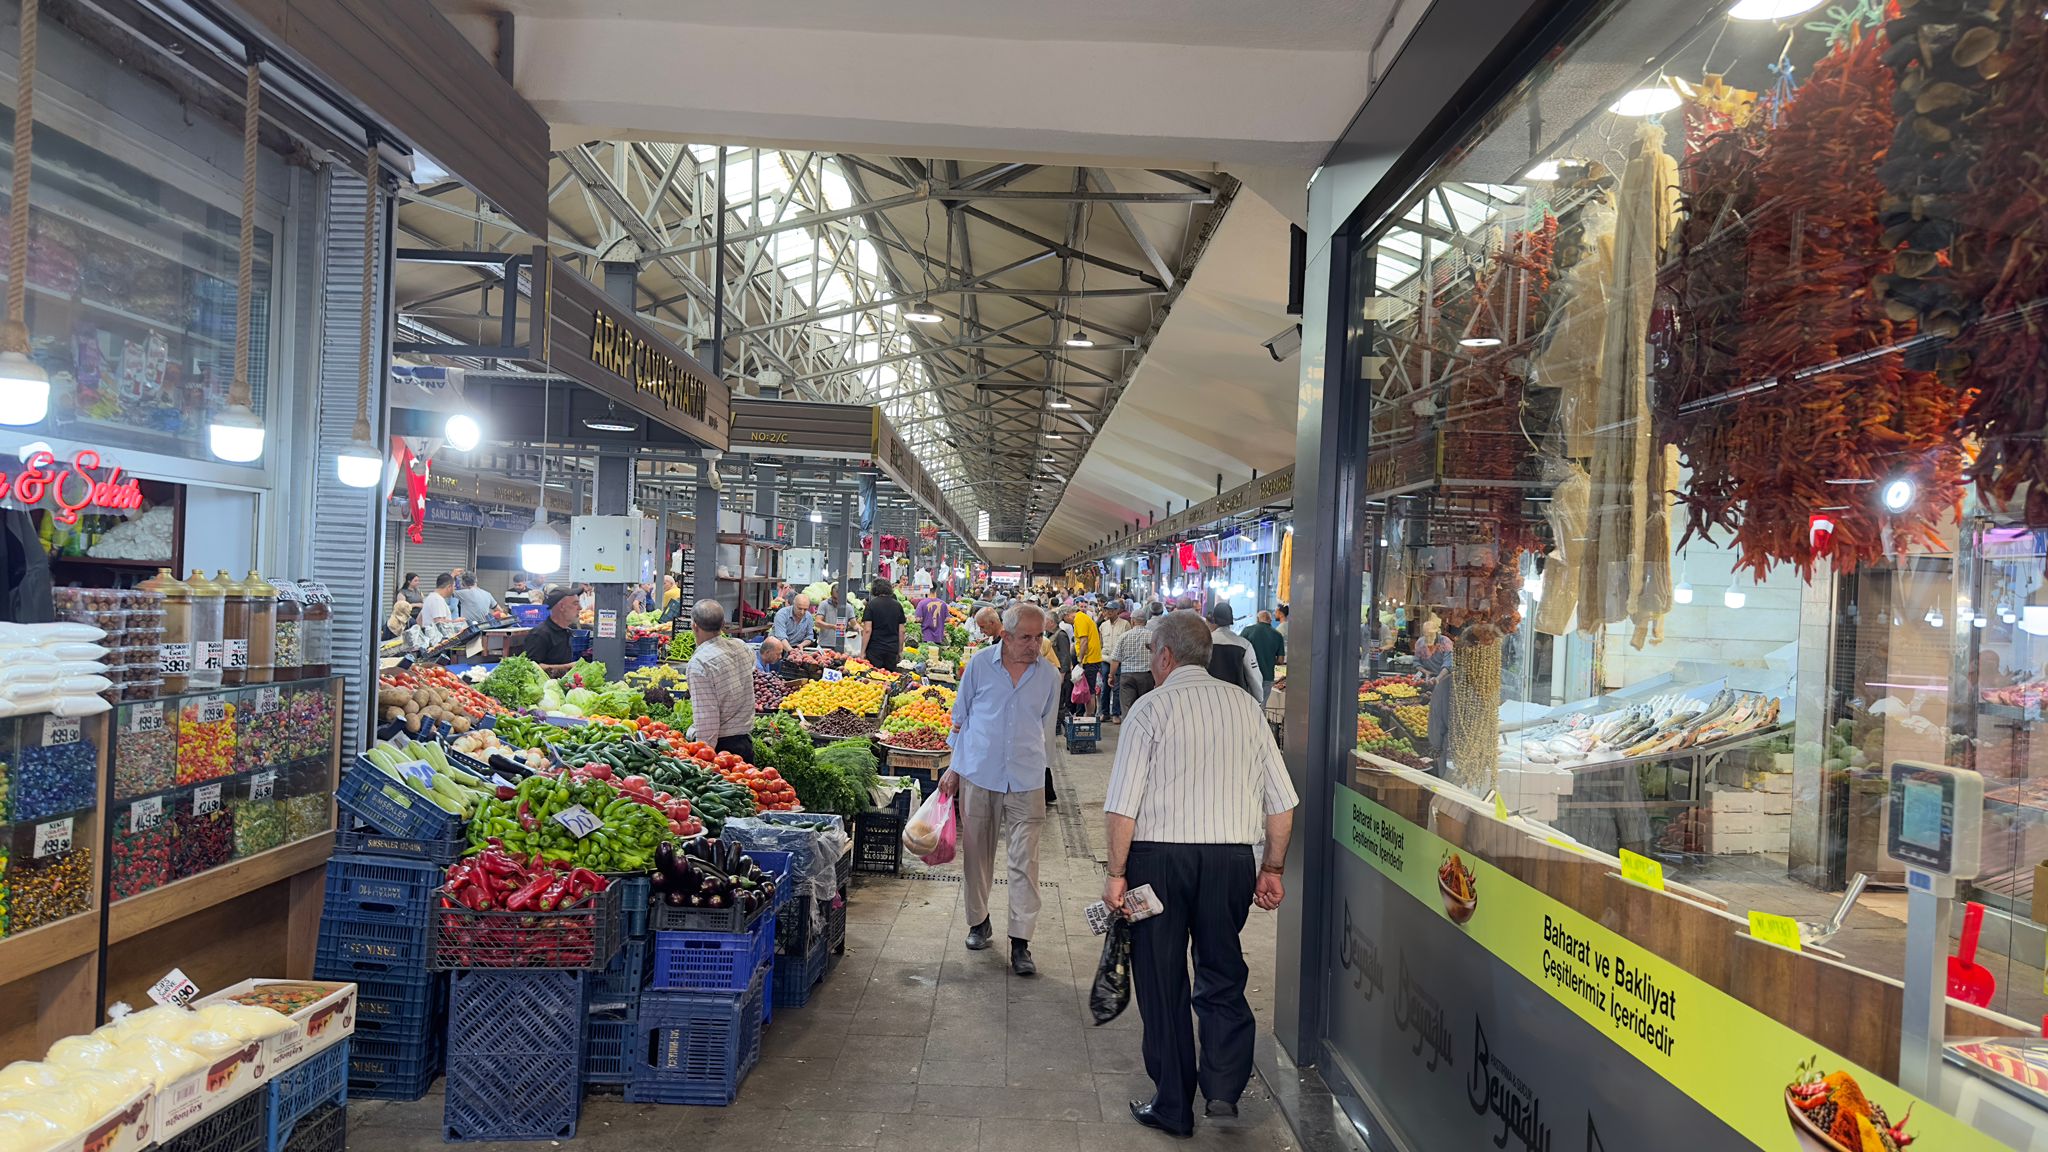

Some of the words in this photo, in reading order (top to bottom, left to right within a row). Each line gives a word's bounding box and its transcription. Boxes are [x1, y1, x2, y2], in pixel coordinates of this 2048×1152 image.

[592, 309, 633, 379] ARAP
[634, 339, 674, 411] ÇAVUŞ
[674, 366, 709, 422] MANAV
[751, 431, 788, 443] NO:2/C
[14, 451, 55, 504] &
[1352, 803, 1373, 831] Baharat
[1373, 819, 1380, 835] ve
[1381, 819, 1404, 850] Bakliyat
[1352, 825, 1379, 856] Çeşitlerimiz
[1543, 914, 1591, 968] Baharat
[1594, 951, 1610, 979] ve
[1614, 956, 1677, 1021] Bakliyat
[1542, 949, 1606, 1012] Çeşitlerimiz
[1610, 986, 1675, 1057] İçeridedir
